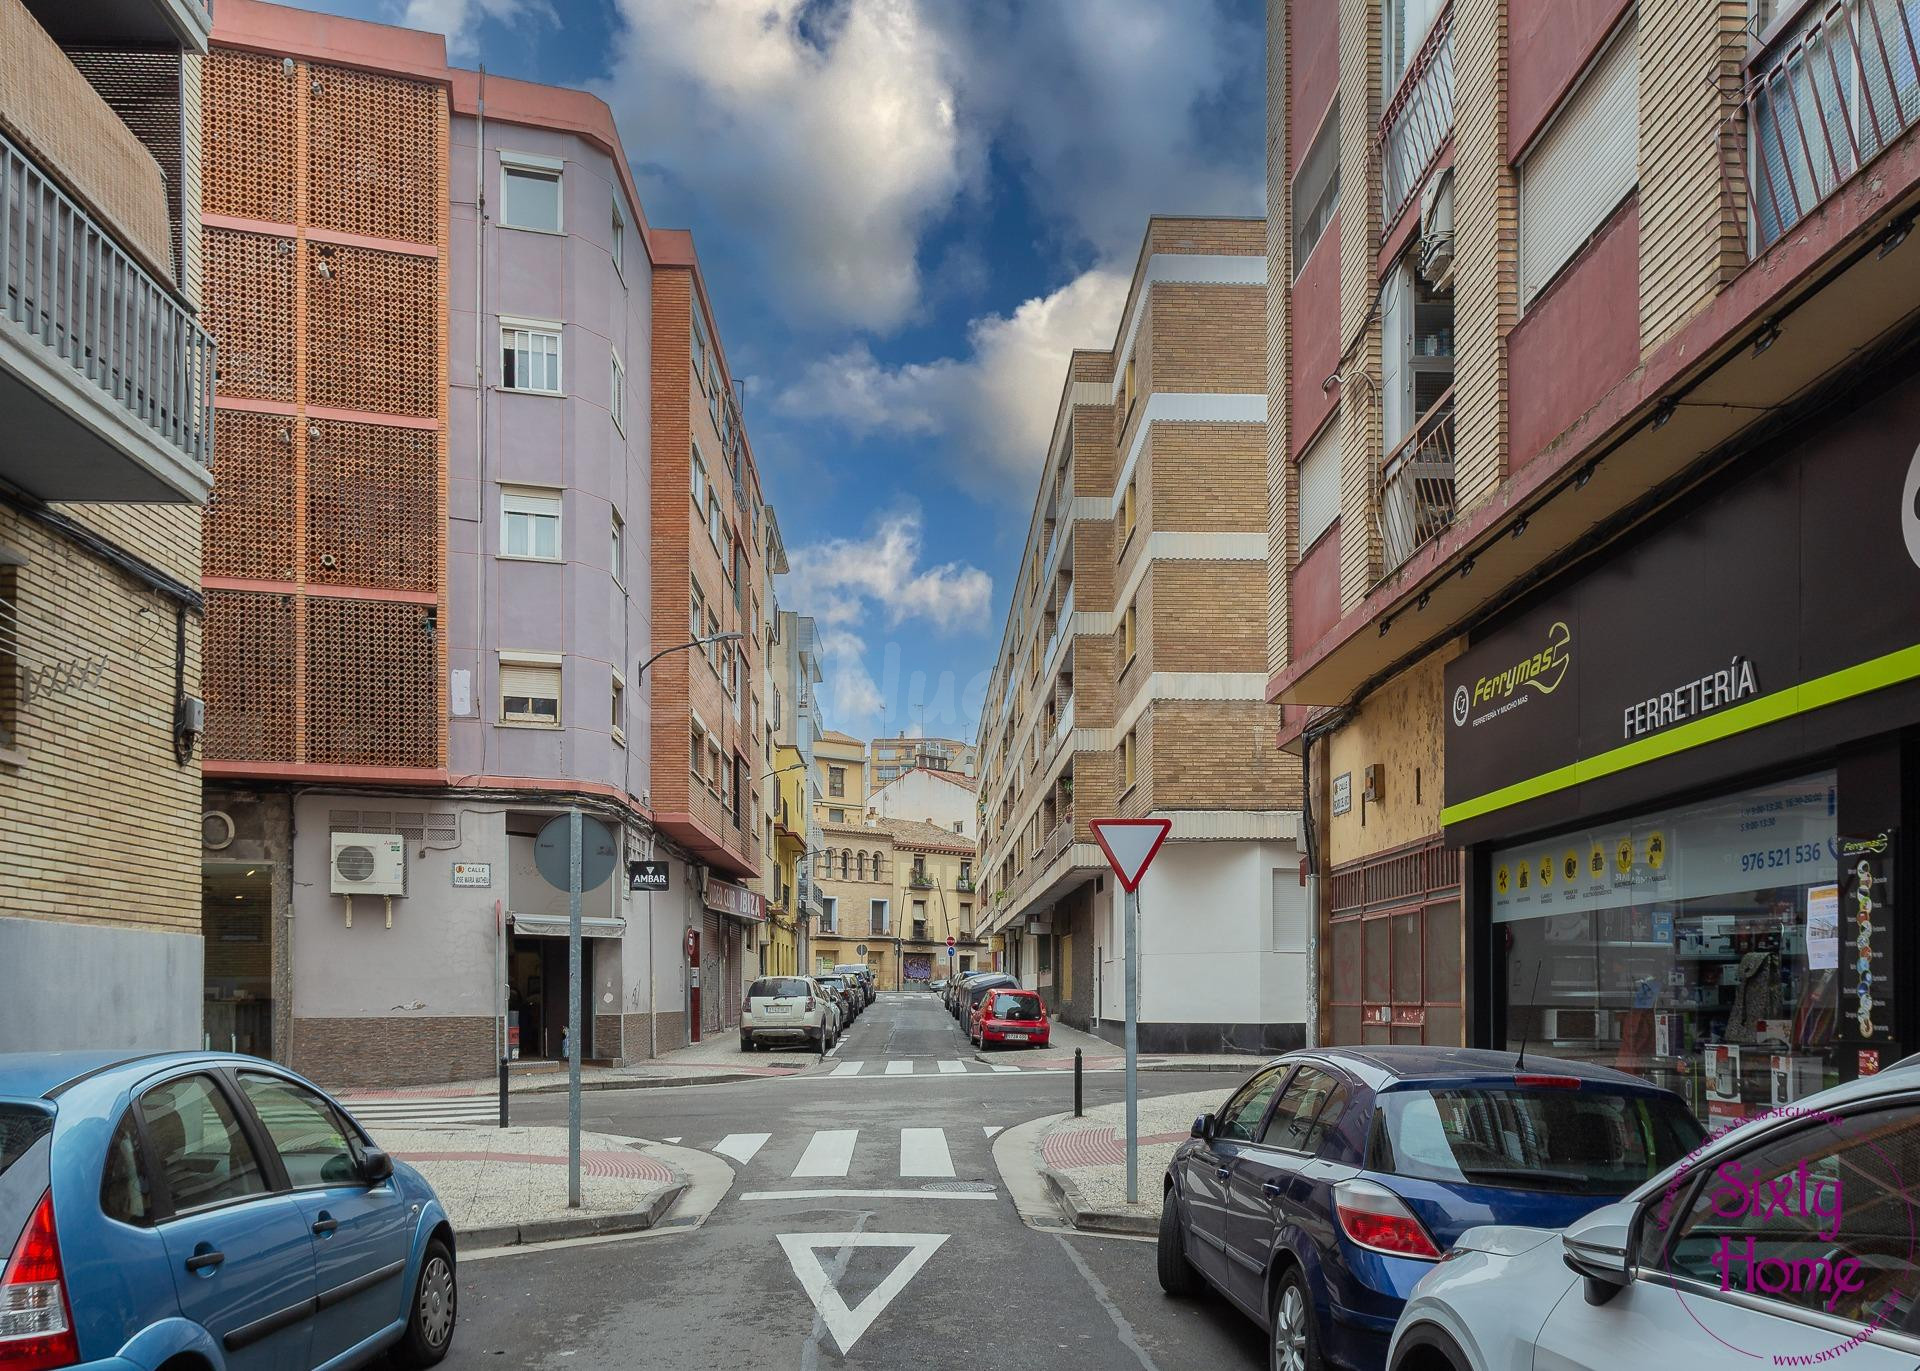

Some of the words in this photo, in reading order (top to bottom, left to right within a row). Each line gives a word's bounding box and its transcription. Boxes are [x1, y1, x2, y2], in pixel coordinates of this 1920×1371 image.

[1472, 646, 1554, 708] Ferrymas
[1501, 700, 1517, 714] MUCHO
[1624, 655, 1757, 739] FERRETERÍA
[1742, 852, 1764, 872] 976
[1768, 848, 1790, 868] 521
[1796, 842, 1821, 864] 536
[633, 874, 667, 884] AMBAR
[740, 891, 761, 917] IBIZA
